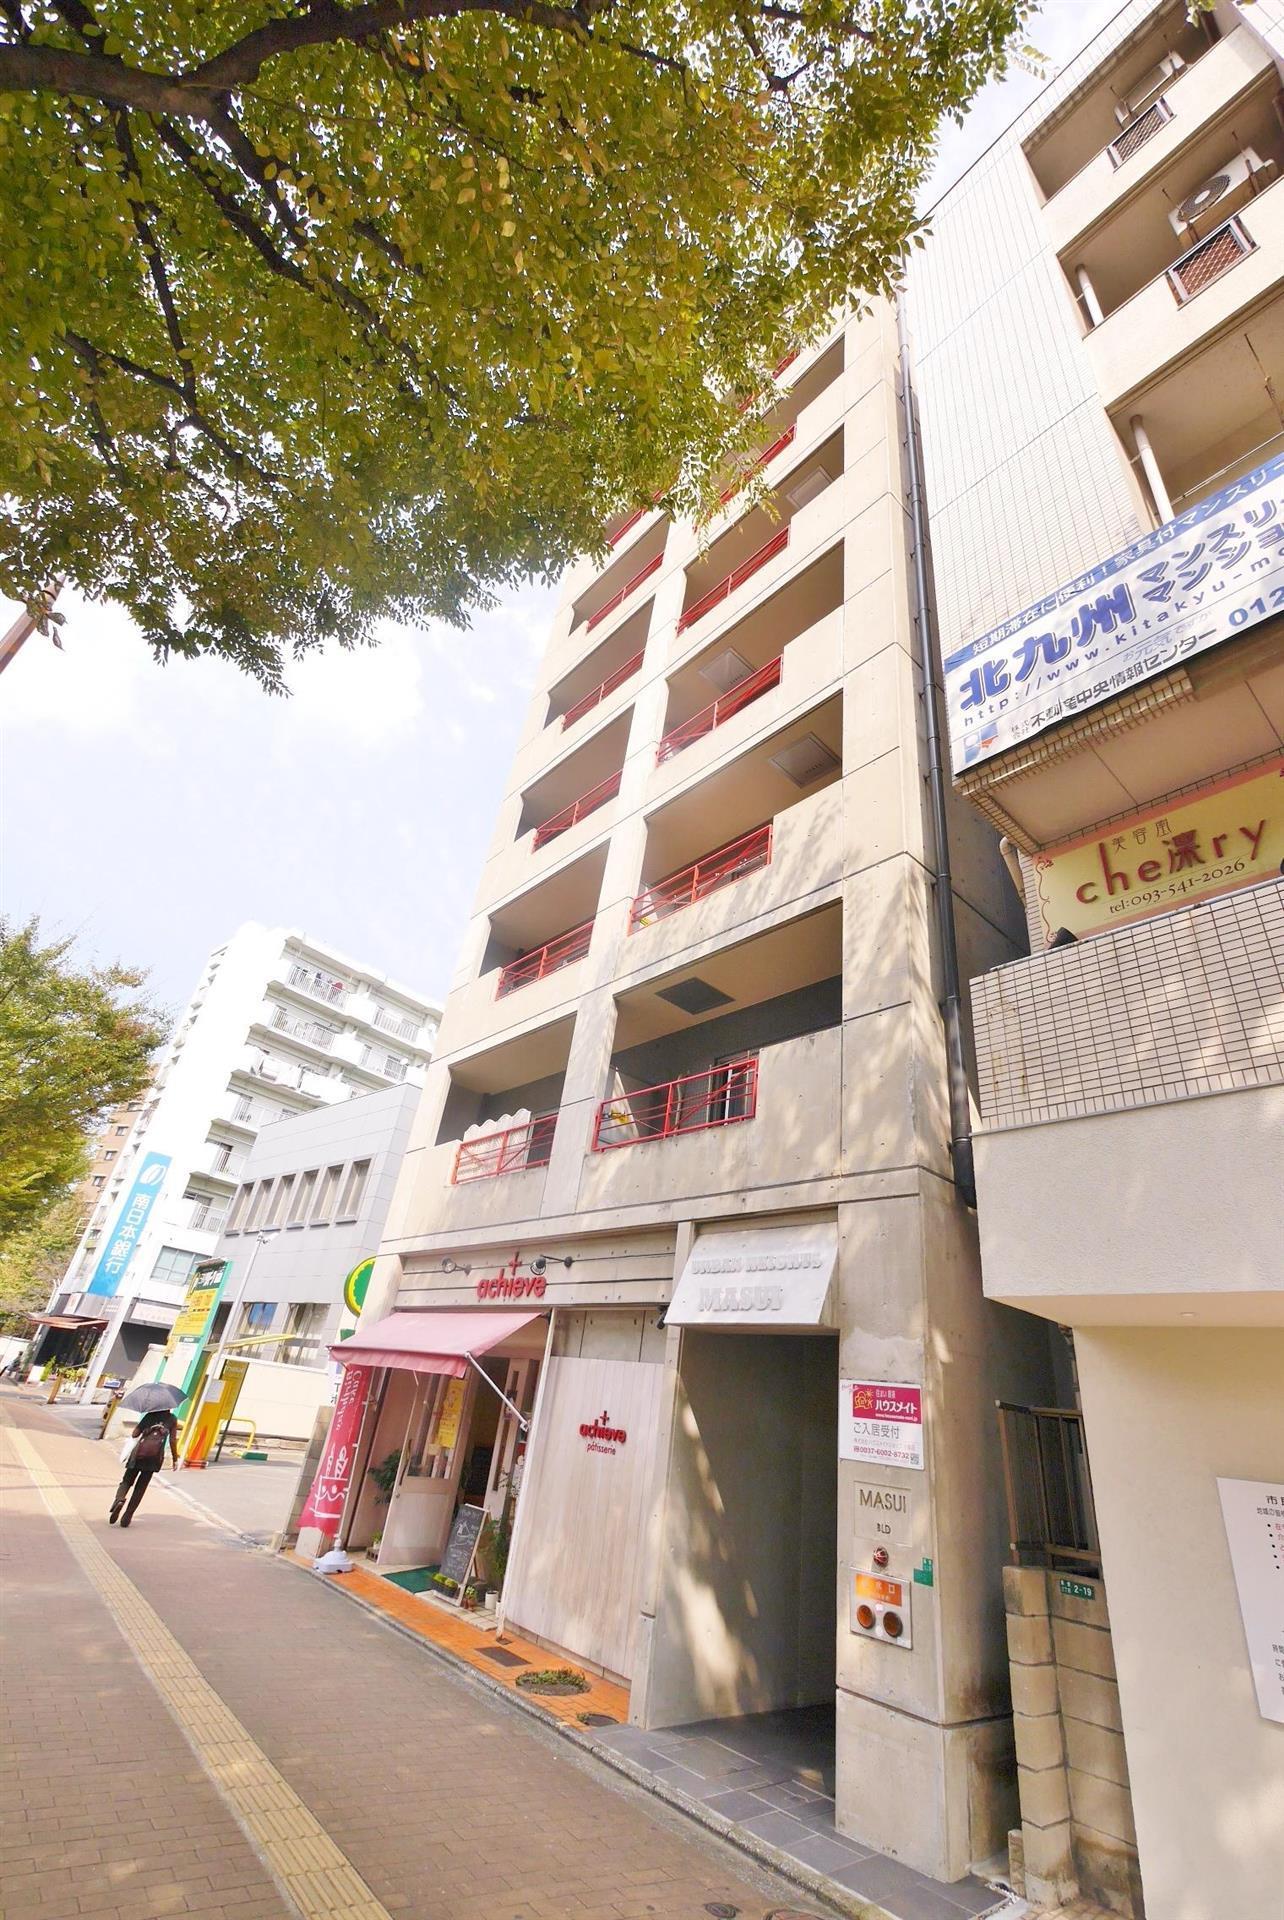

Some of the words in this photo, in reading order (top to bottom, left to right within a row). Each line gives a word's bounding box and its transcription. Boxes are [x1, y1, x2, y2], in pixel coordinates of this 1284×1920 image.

[1137, 499, 1284, 583] マンスリ
[959, 581, 1137, 712] 北九州
[1110, 858, 1246, 914] tel:093-541-2026
[104, 1193, 153, 1275] 南日本銀行
[476, 1267, 547, 1299] achieve
[875, 1399, 918, 1415] ハウスメイト
[579, 1417, 628, 1444] achieve
[853, 1422, 901, 1440] ご入居受付
[858, 1488, 908, 1514] MASUI
